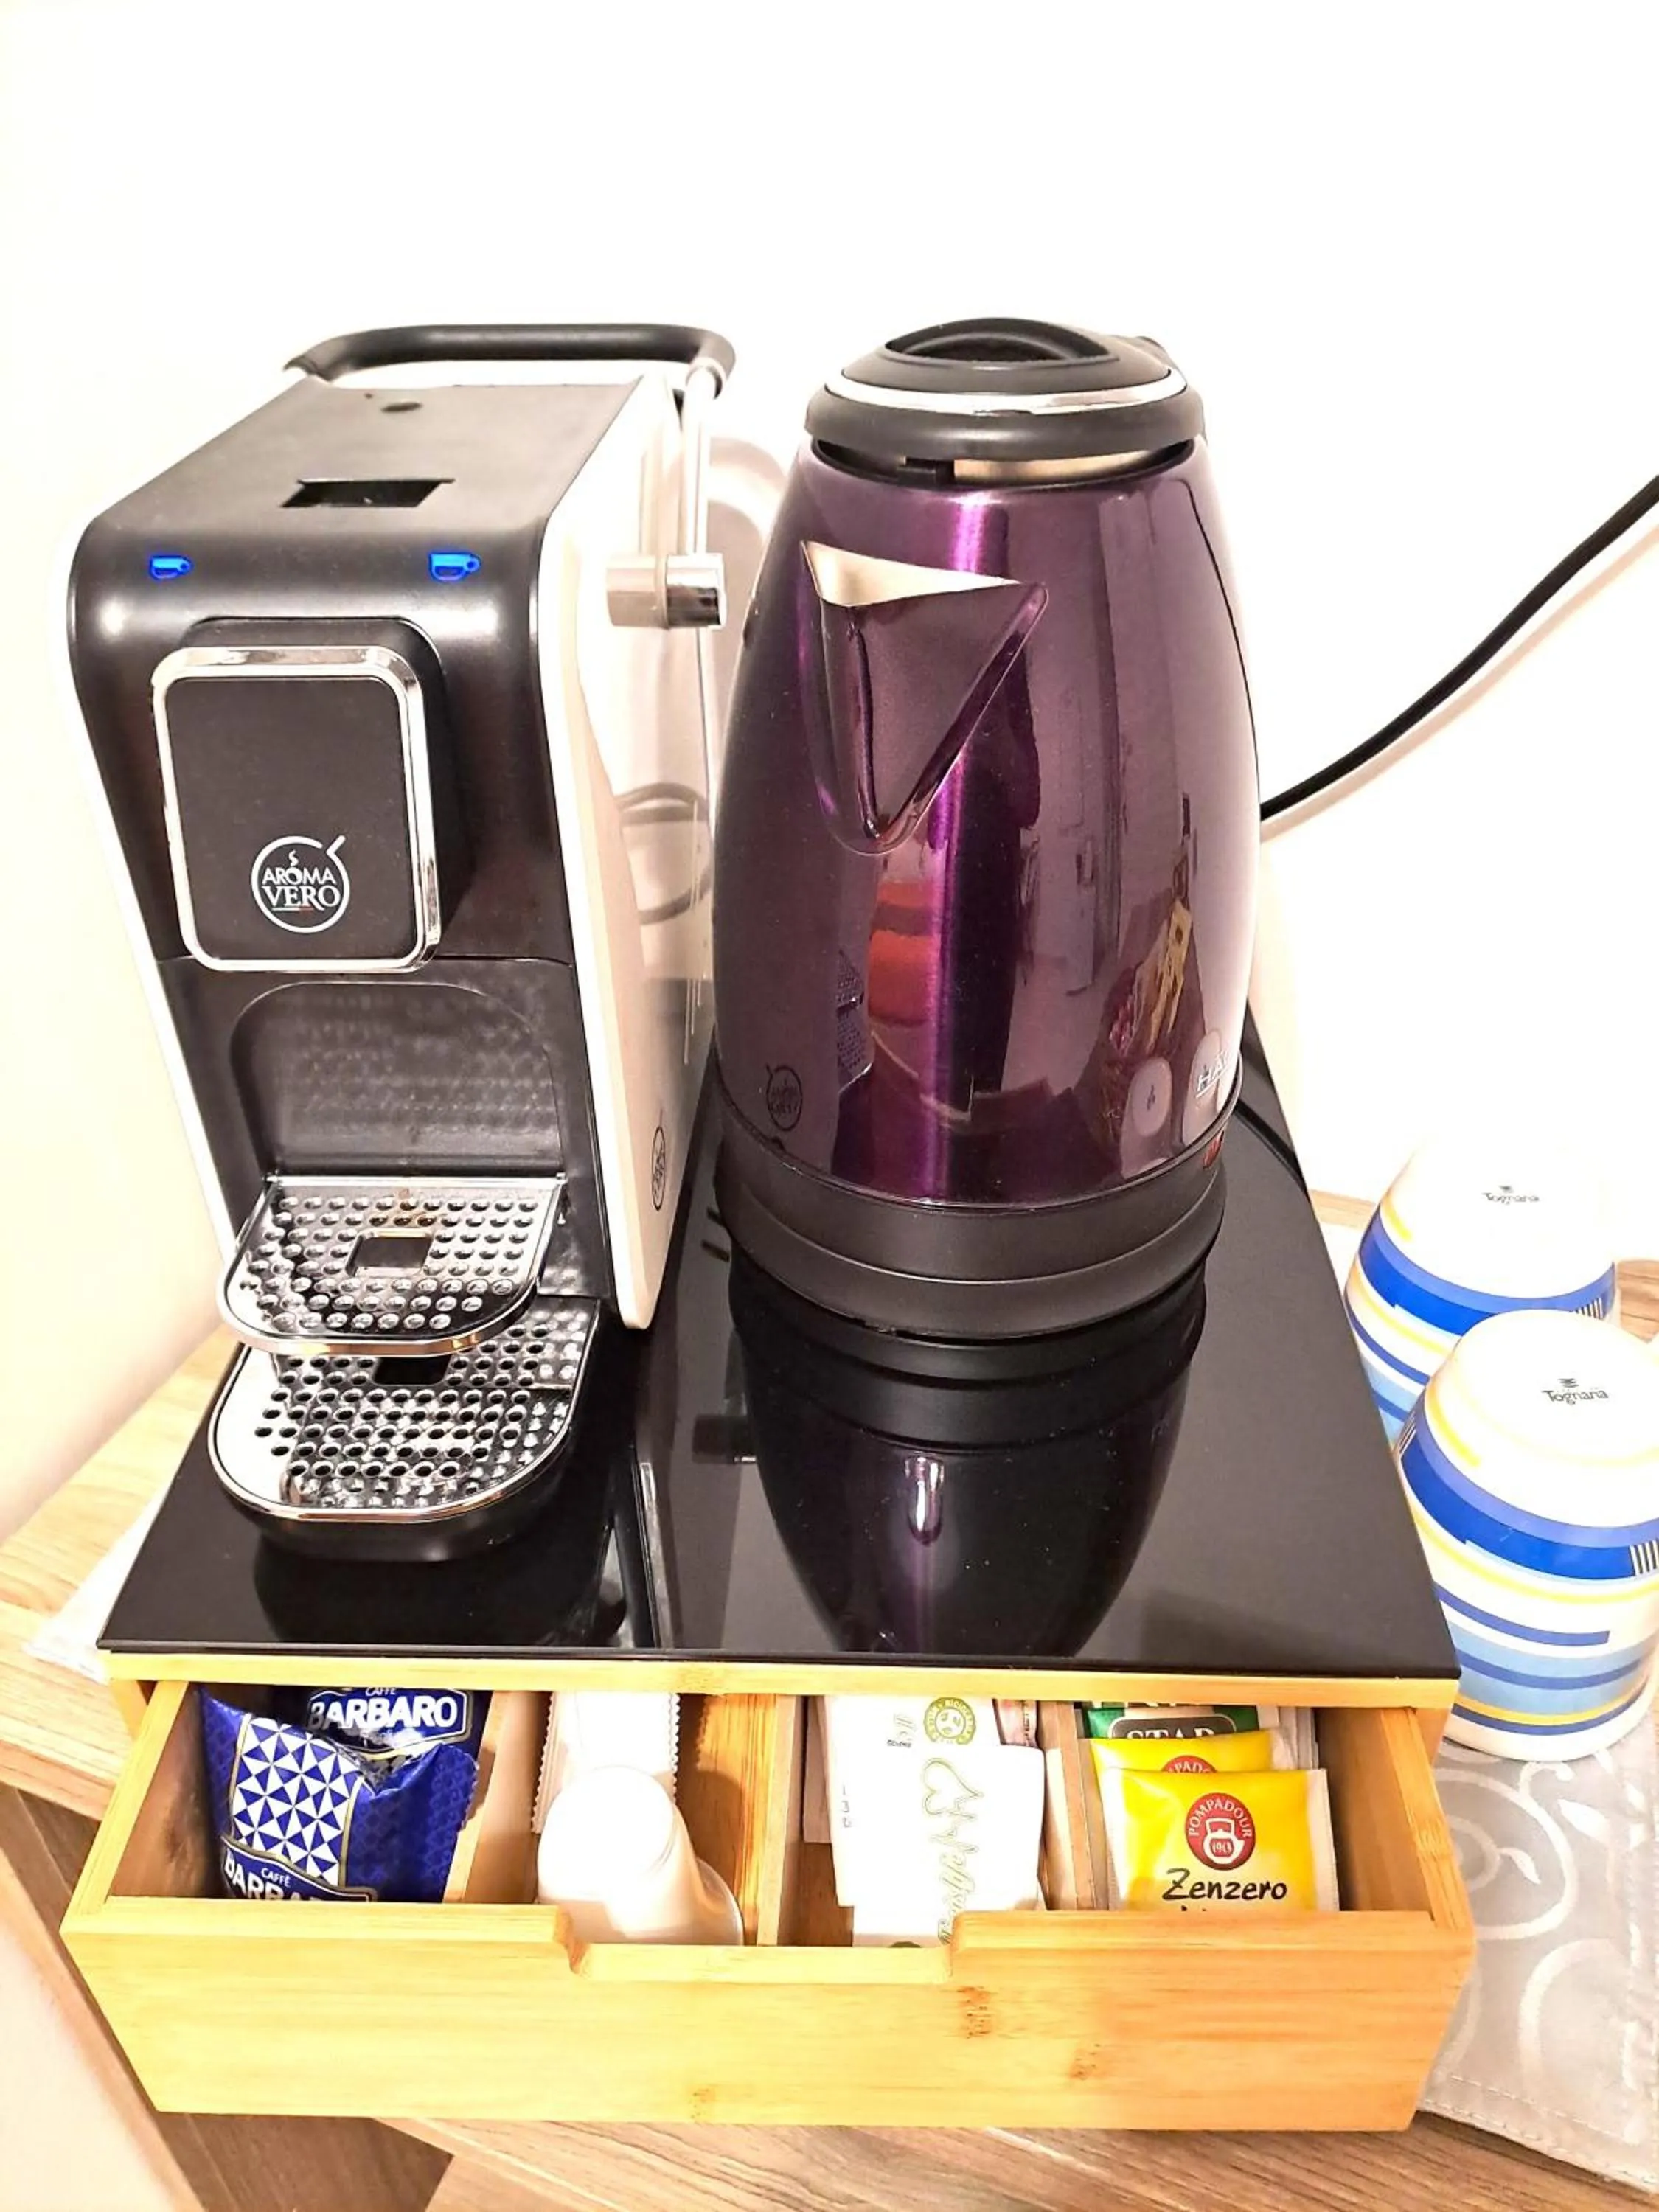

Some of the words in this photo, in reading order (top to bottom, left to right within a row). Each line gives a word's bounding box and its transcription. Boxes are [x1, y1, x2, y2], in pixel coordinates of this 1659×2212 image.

[262, 867, 337, 885] AROMA
[261, 886, 341, 911] VERO
[1541, 1390, 1609, 1405] Tognana
[307, 1695, 458, 1731] BARBARO
[1188, 1797, 1253, 1838] POMPADOUR
[1162, 1868, 1288, 1900] Zenzero
